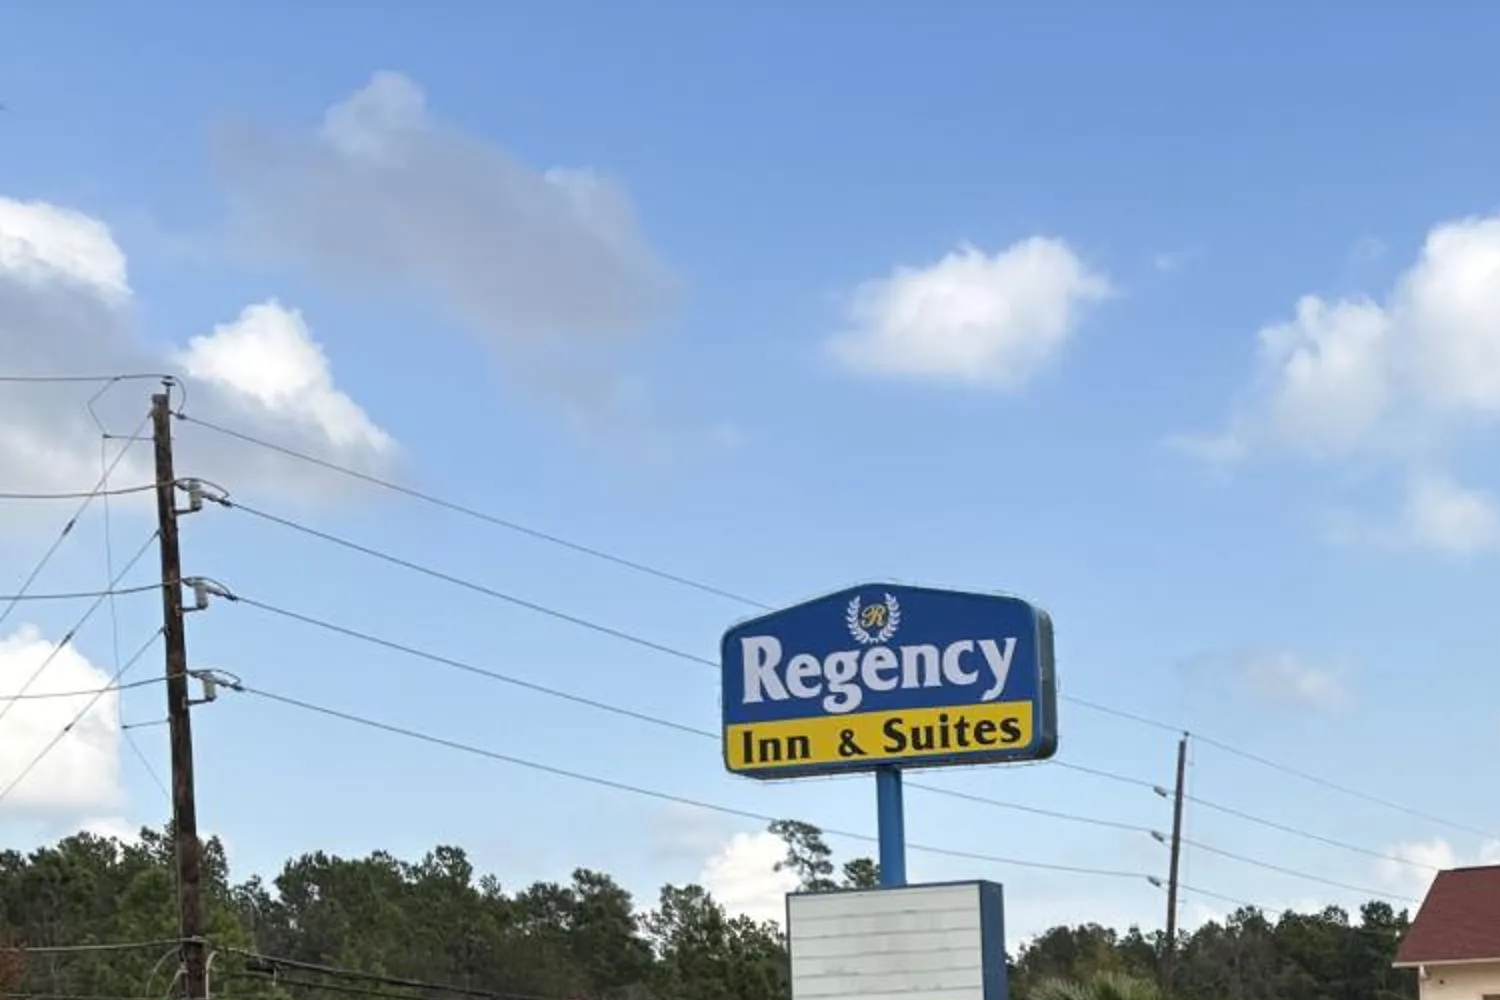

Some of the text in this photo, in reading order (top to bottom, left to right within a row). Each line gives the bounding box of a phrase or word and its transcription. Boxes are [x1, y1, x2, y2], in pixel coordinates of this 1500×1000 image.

[861, 603, 887, 628] R
[740, 634, 1018, 714] Regency
[742, 713, 1022, 765] Inn & Suites
